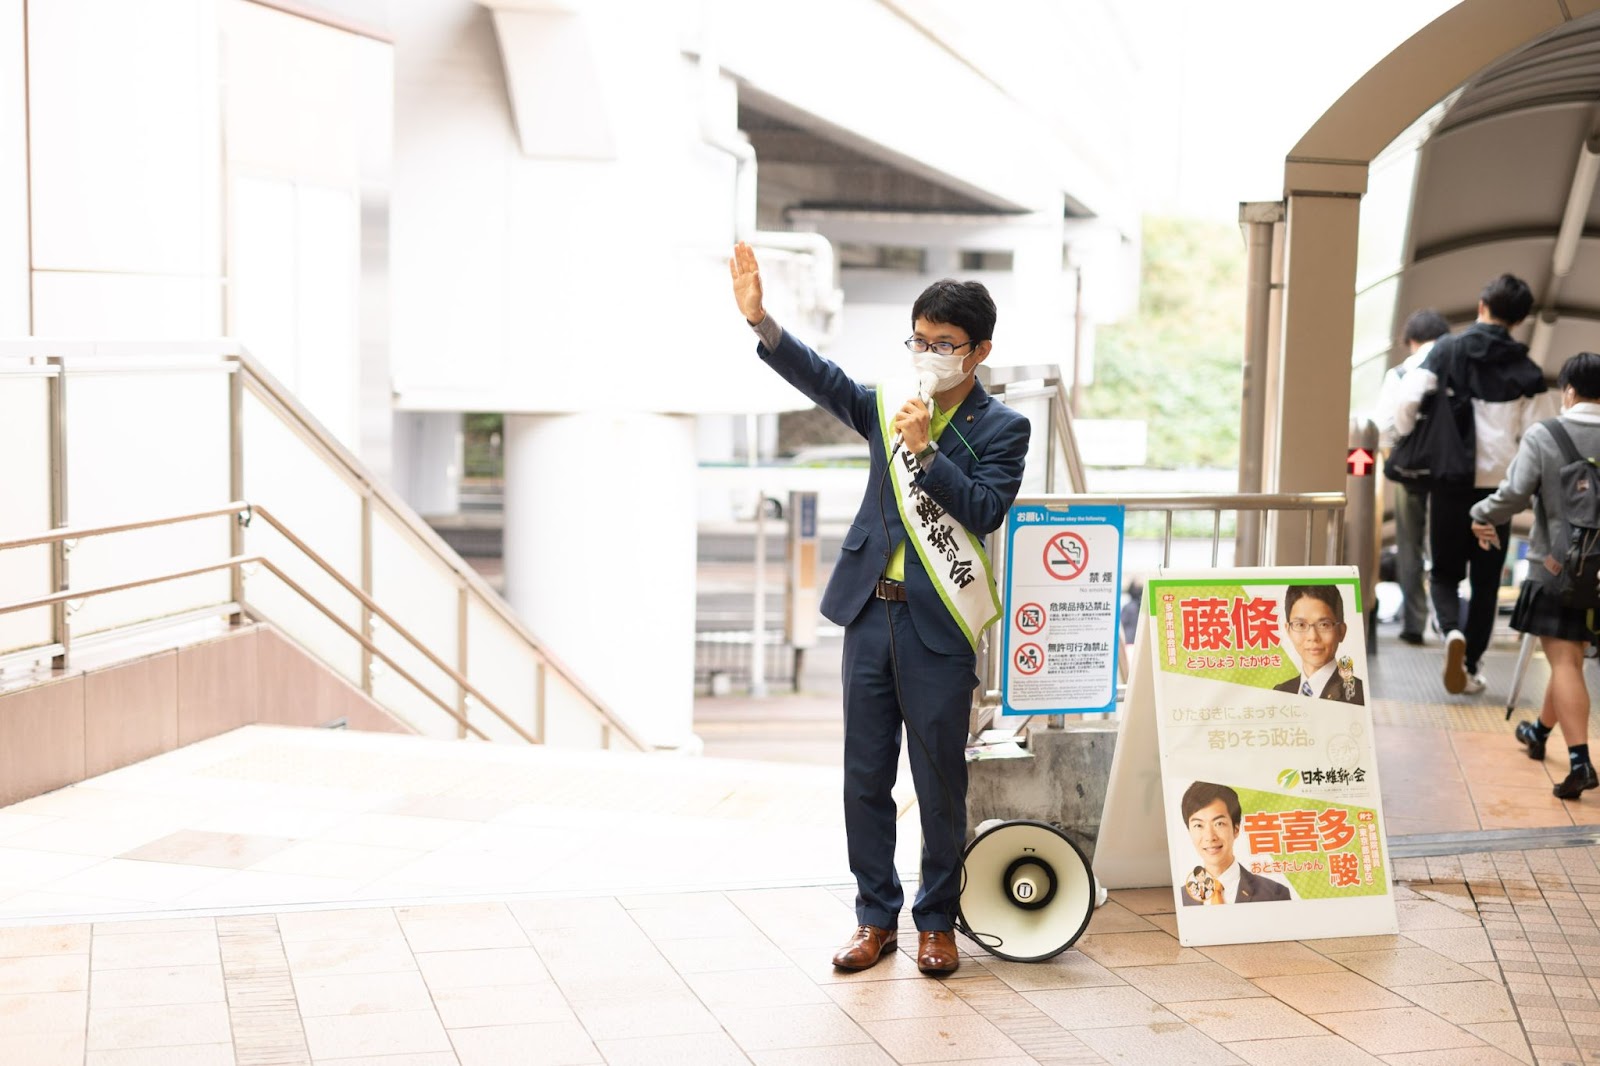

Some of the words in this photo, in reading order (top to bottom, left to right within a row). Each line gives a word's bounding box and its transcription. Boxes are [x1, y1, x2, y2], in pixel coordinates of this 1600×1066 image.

[1016, 511, 1045, 523] お願い
[1049, 601, 1111, 612] 危険品持込禁止
[1180, 597, 1281, 651] 藤條
[1047, 642, 1109, 653] 無許可行為禁止
[1187, 656, 1235, 669] とうじょう
[1239, 655, 1281, 668] たかゆき
[1172, 705, 1309, 722] ひたむきに、まっすぐに。
[1207, 728, 1316, 750] 寄りそう政治。
[1301, 767, 1366, 786] 日本維新の会
[1244, 808, 1356, 855] 音喜多
[1250, 858, 1324, 874] おときたしゅん
[1329, 852, 1361, 888] 駿
